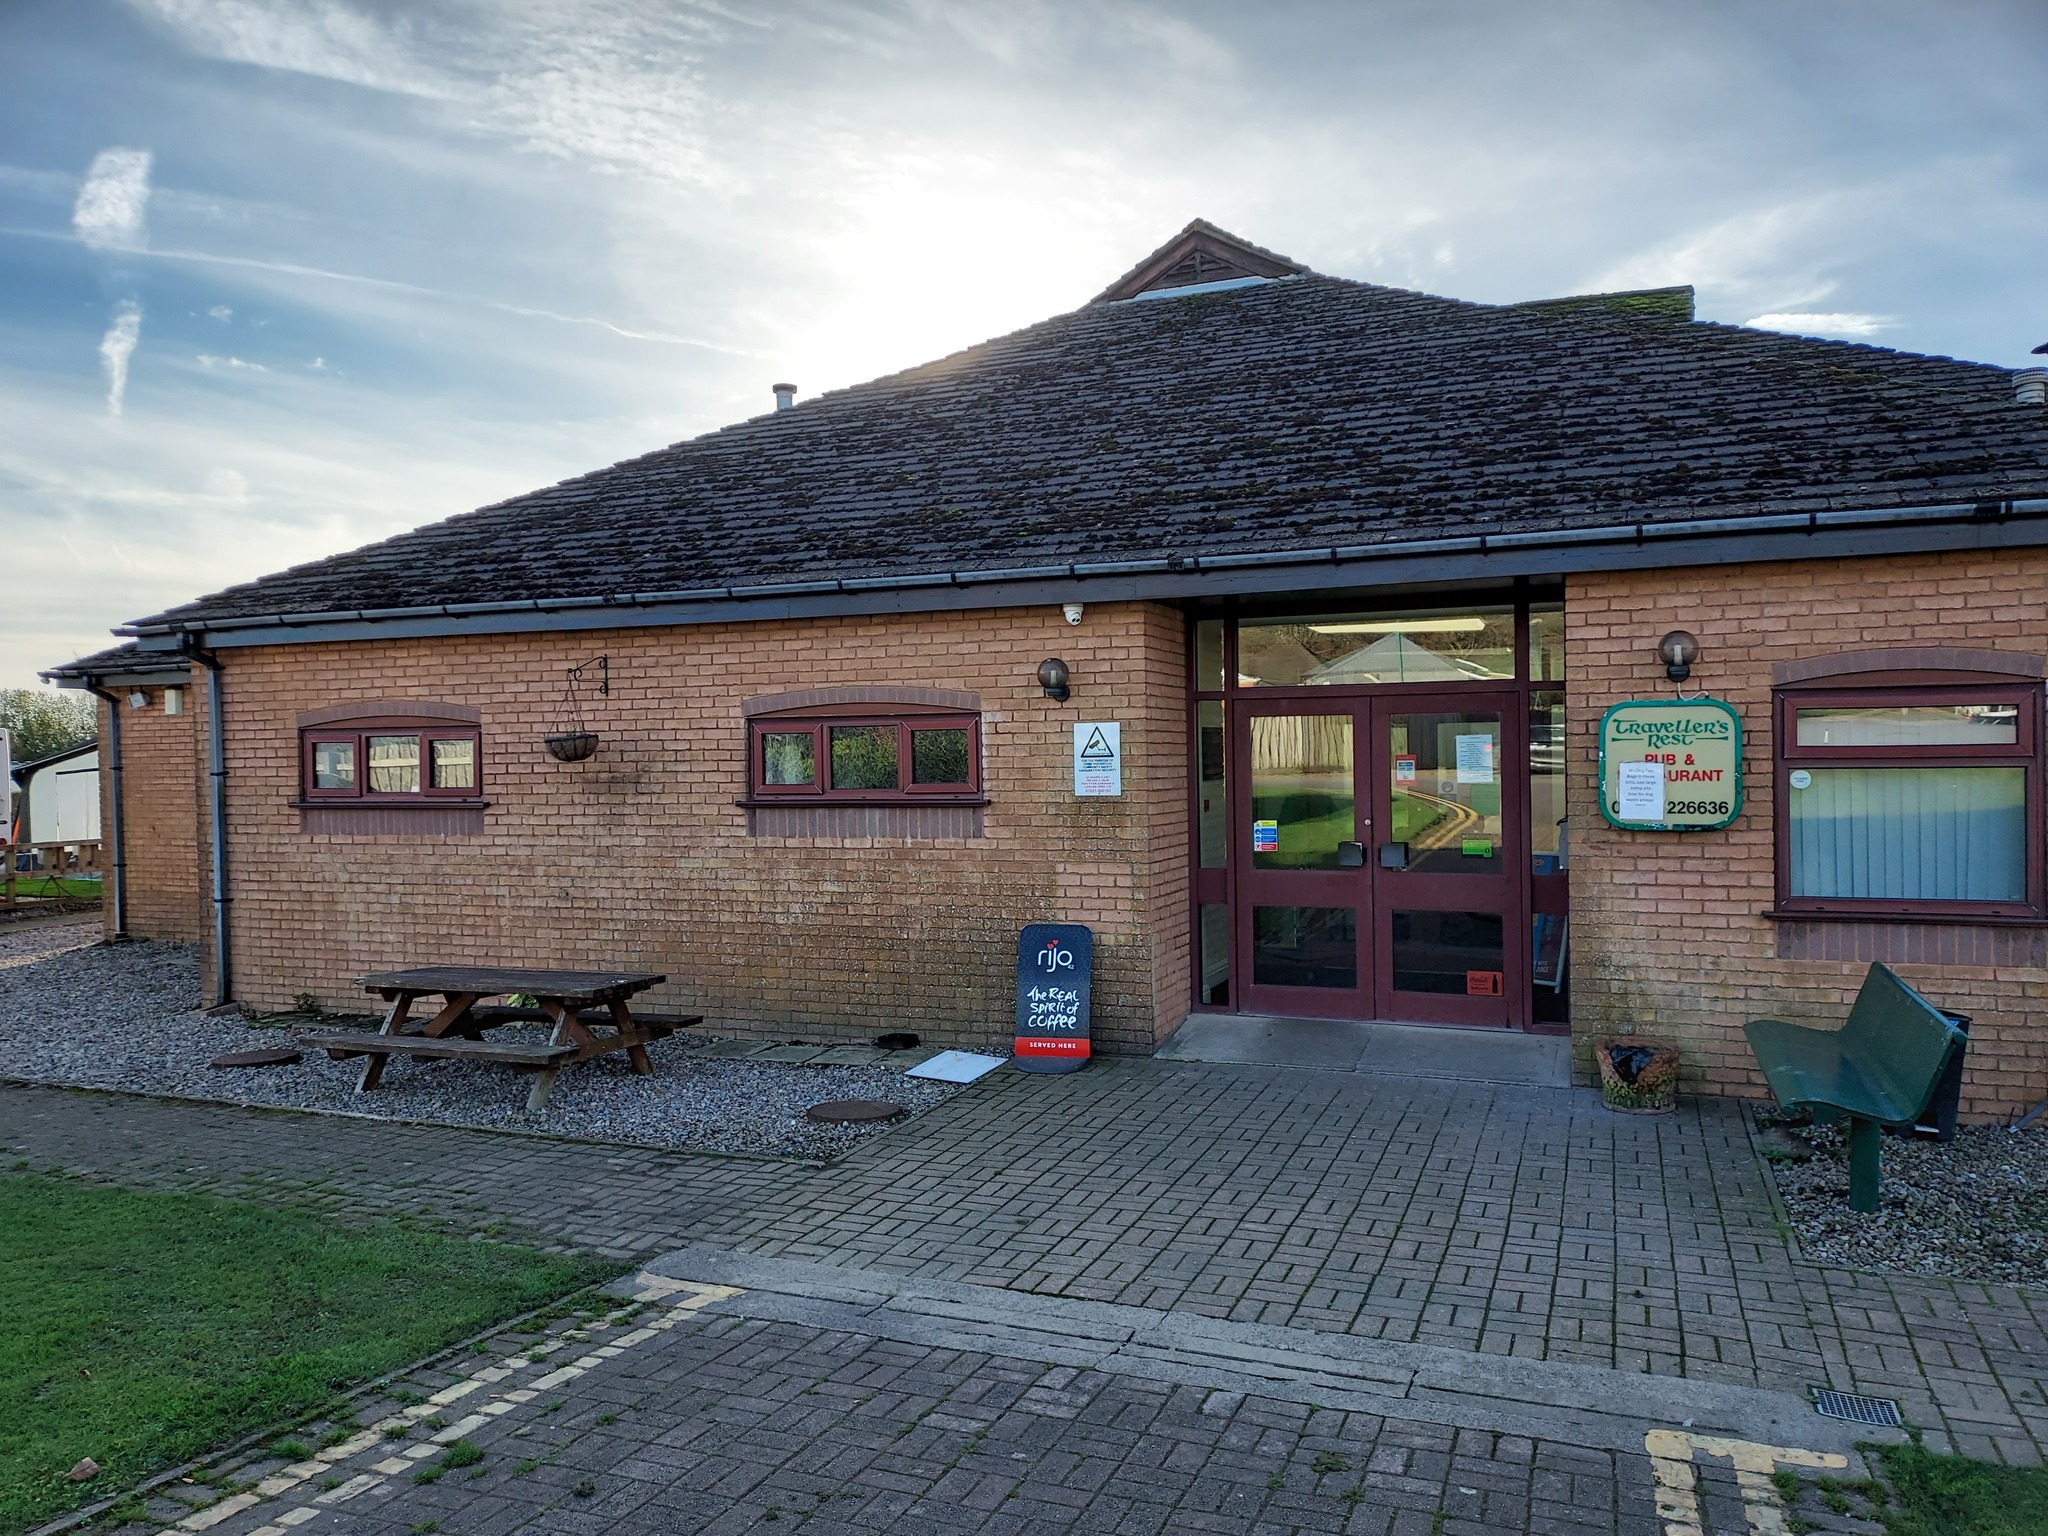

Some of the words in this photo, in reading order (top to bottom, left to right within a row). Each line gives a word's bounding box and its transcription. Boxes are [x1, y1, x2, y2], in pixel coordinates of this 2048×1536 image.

[1645, 754, 1676, 765] PUB
[1684, 754, 1695, 765] &
[1667, 801, 1729, 815] 226636
[1038, 941, 1072, 972] rijo
[1067, 1002, 1079, 1015] of
